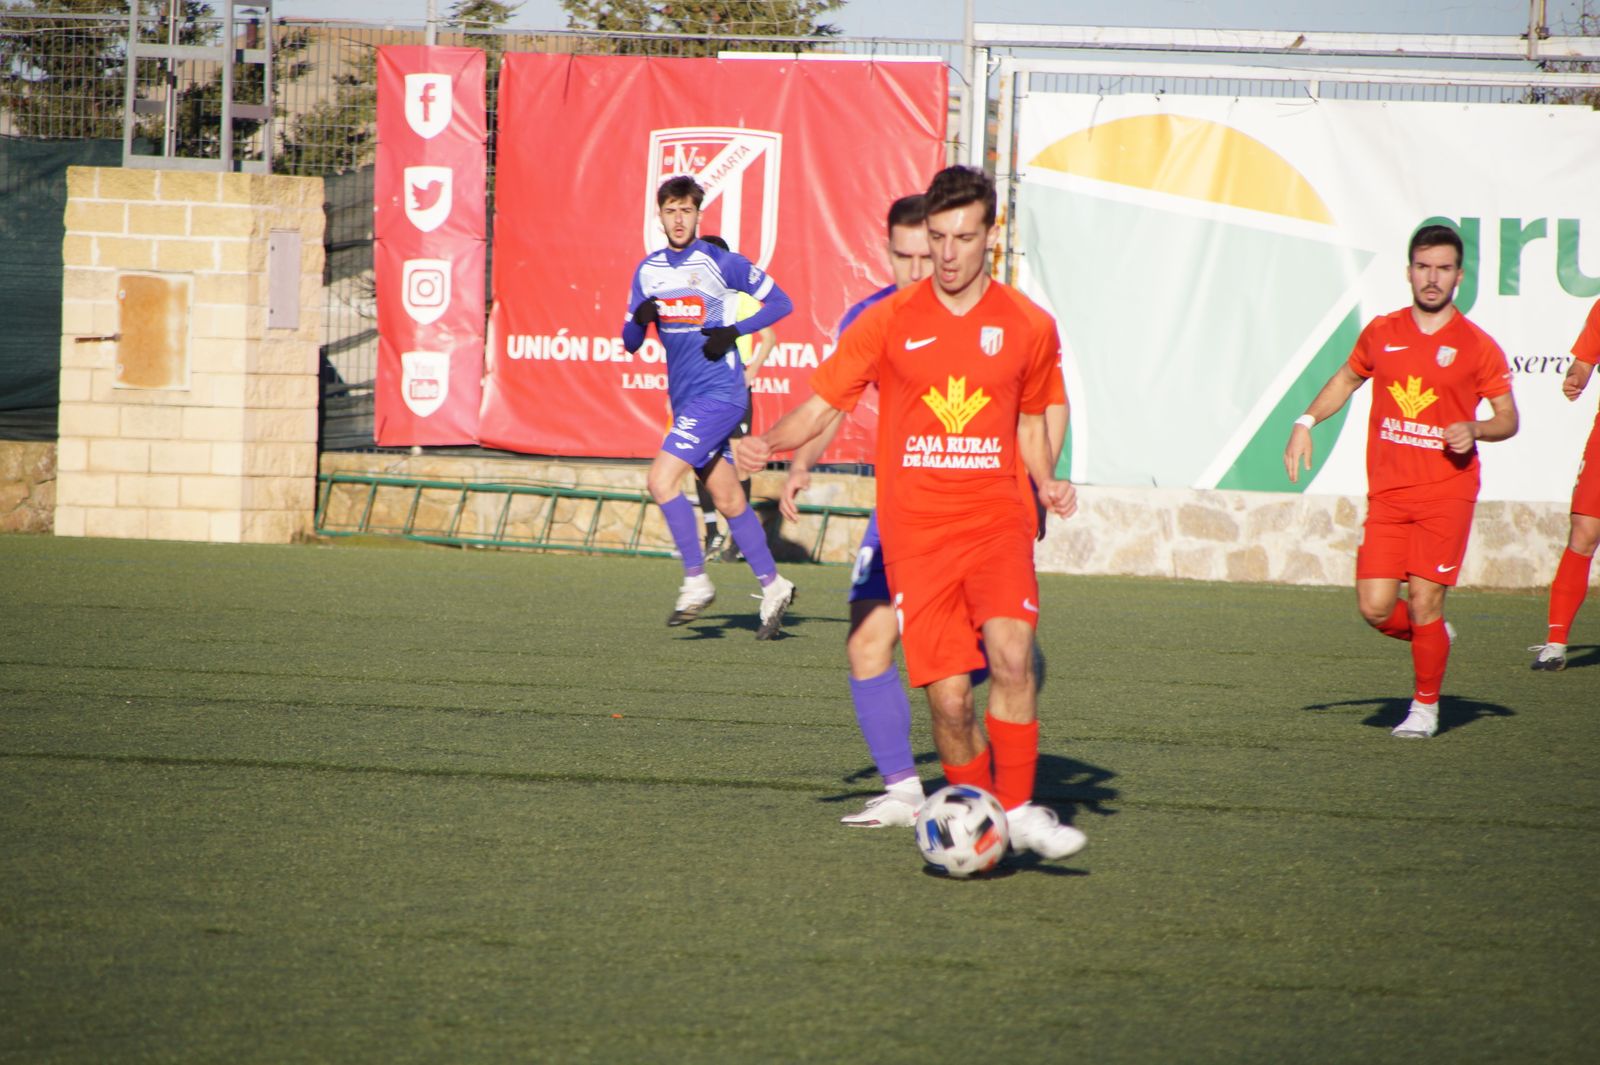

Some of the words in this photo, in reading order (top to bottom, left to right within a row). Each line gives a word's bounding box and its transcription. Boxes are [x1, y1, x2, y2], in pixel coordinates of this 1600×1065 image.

[710, 145, 751, 183] MARTA
[507, 328, 589, 361] UNIÓN
[1381, 416, 1402, 432] AJA
[905, 435, 944, 455] CAJA
[946, 436, 1002, 453] RURAL
[902, 454, 921, 467] DE
[922, 454, 1001, 469] SALAMANCA
